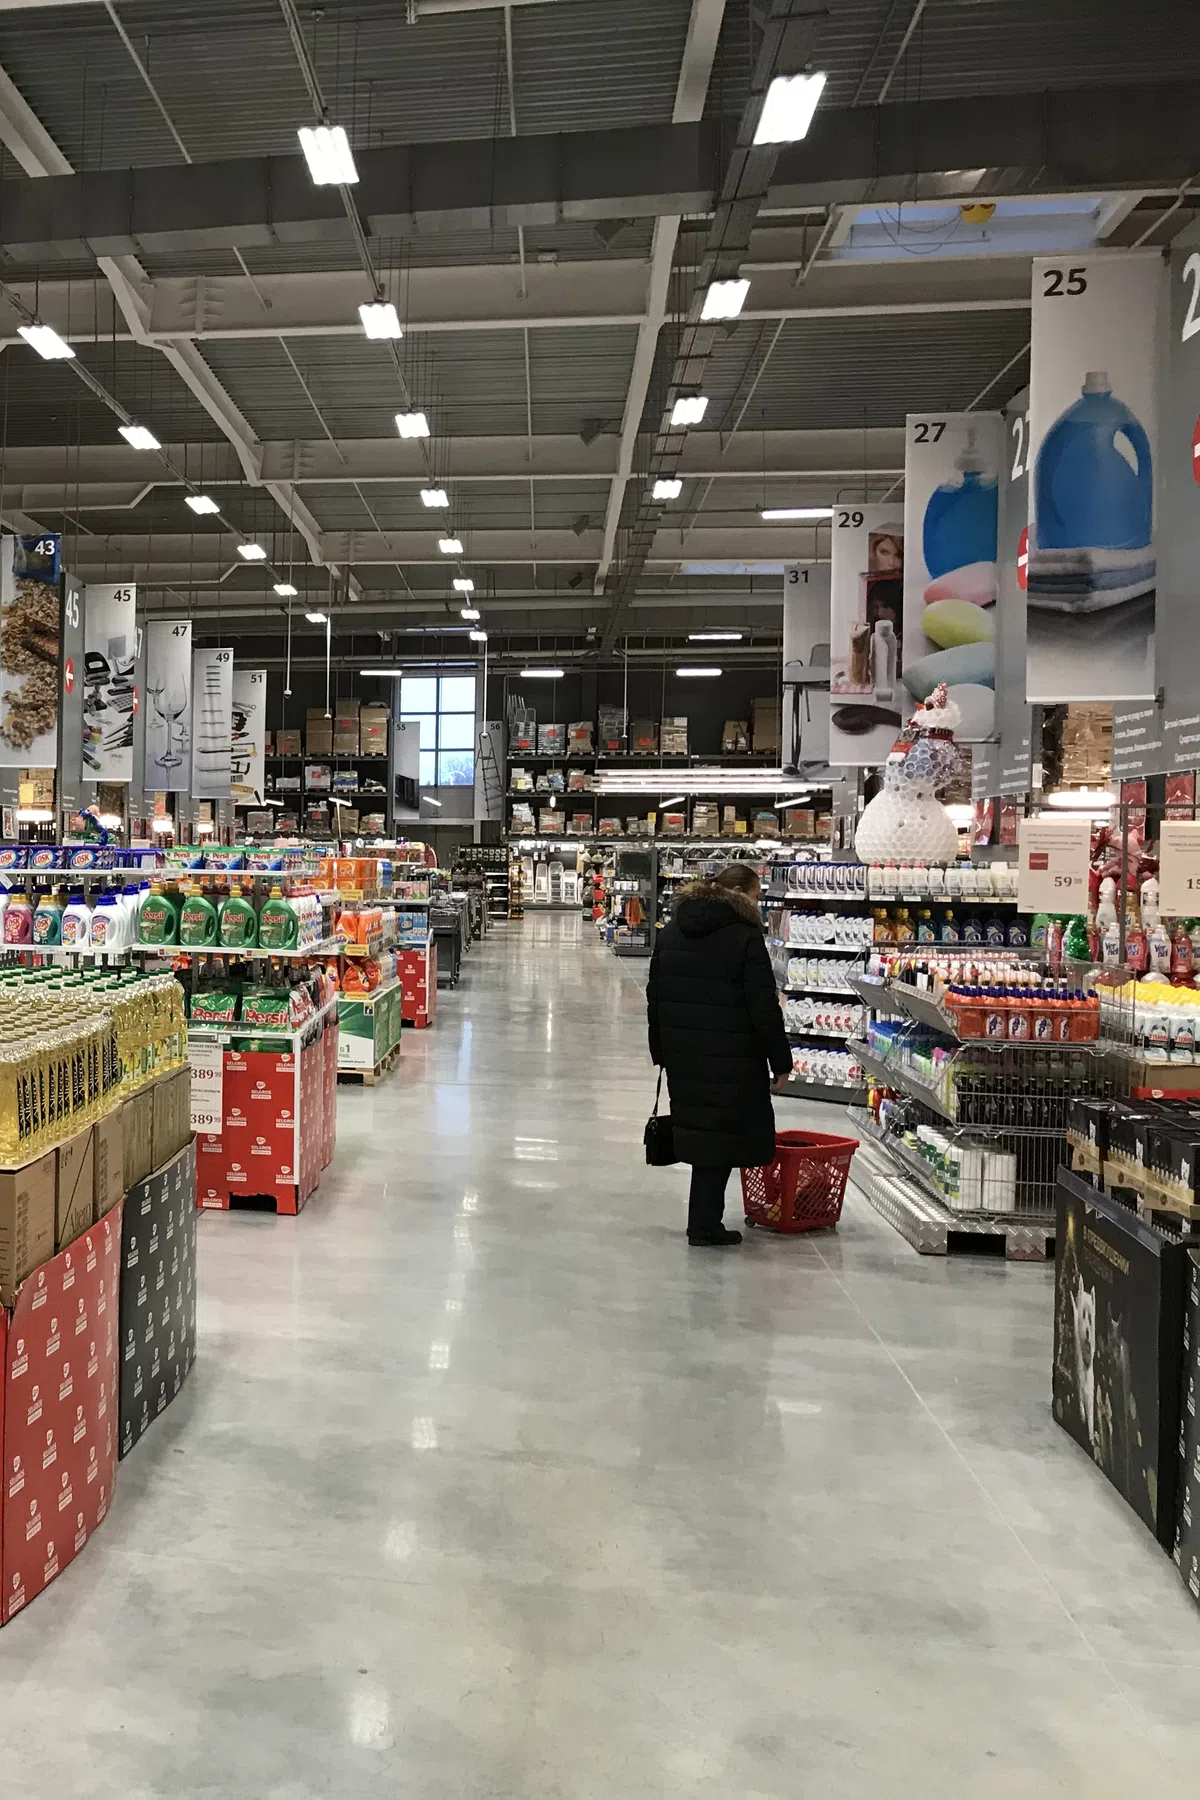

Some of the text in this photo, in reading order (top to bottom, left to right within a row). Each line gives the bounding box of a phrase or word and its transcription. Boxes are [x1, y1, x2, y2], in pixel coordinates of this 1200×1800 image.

[1043, 267, 1088, 297] 25
[914, 422, 946, 443] 27
[838, 512, 864, 527] 29
[34, 540, 55, 555] 43
[789, 570, 809, 583] 31
[113, 589, 132, 602] 45
[65, 589, 79, 628] 45
[172, 625, 187, 637] 47
[216, 652, 229, 663] 49
[250, 674, 263, 684] 51
[1054, 877, 1072, 887] 59
[191, 1069, 213, 1079] 389
[190, 1114, 213, 1124] 389
